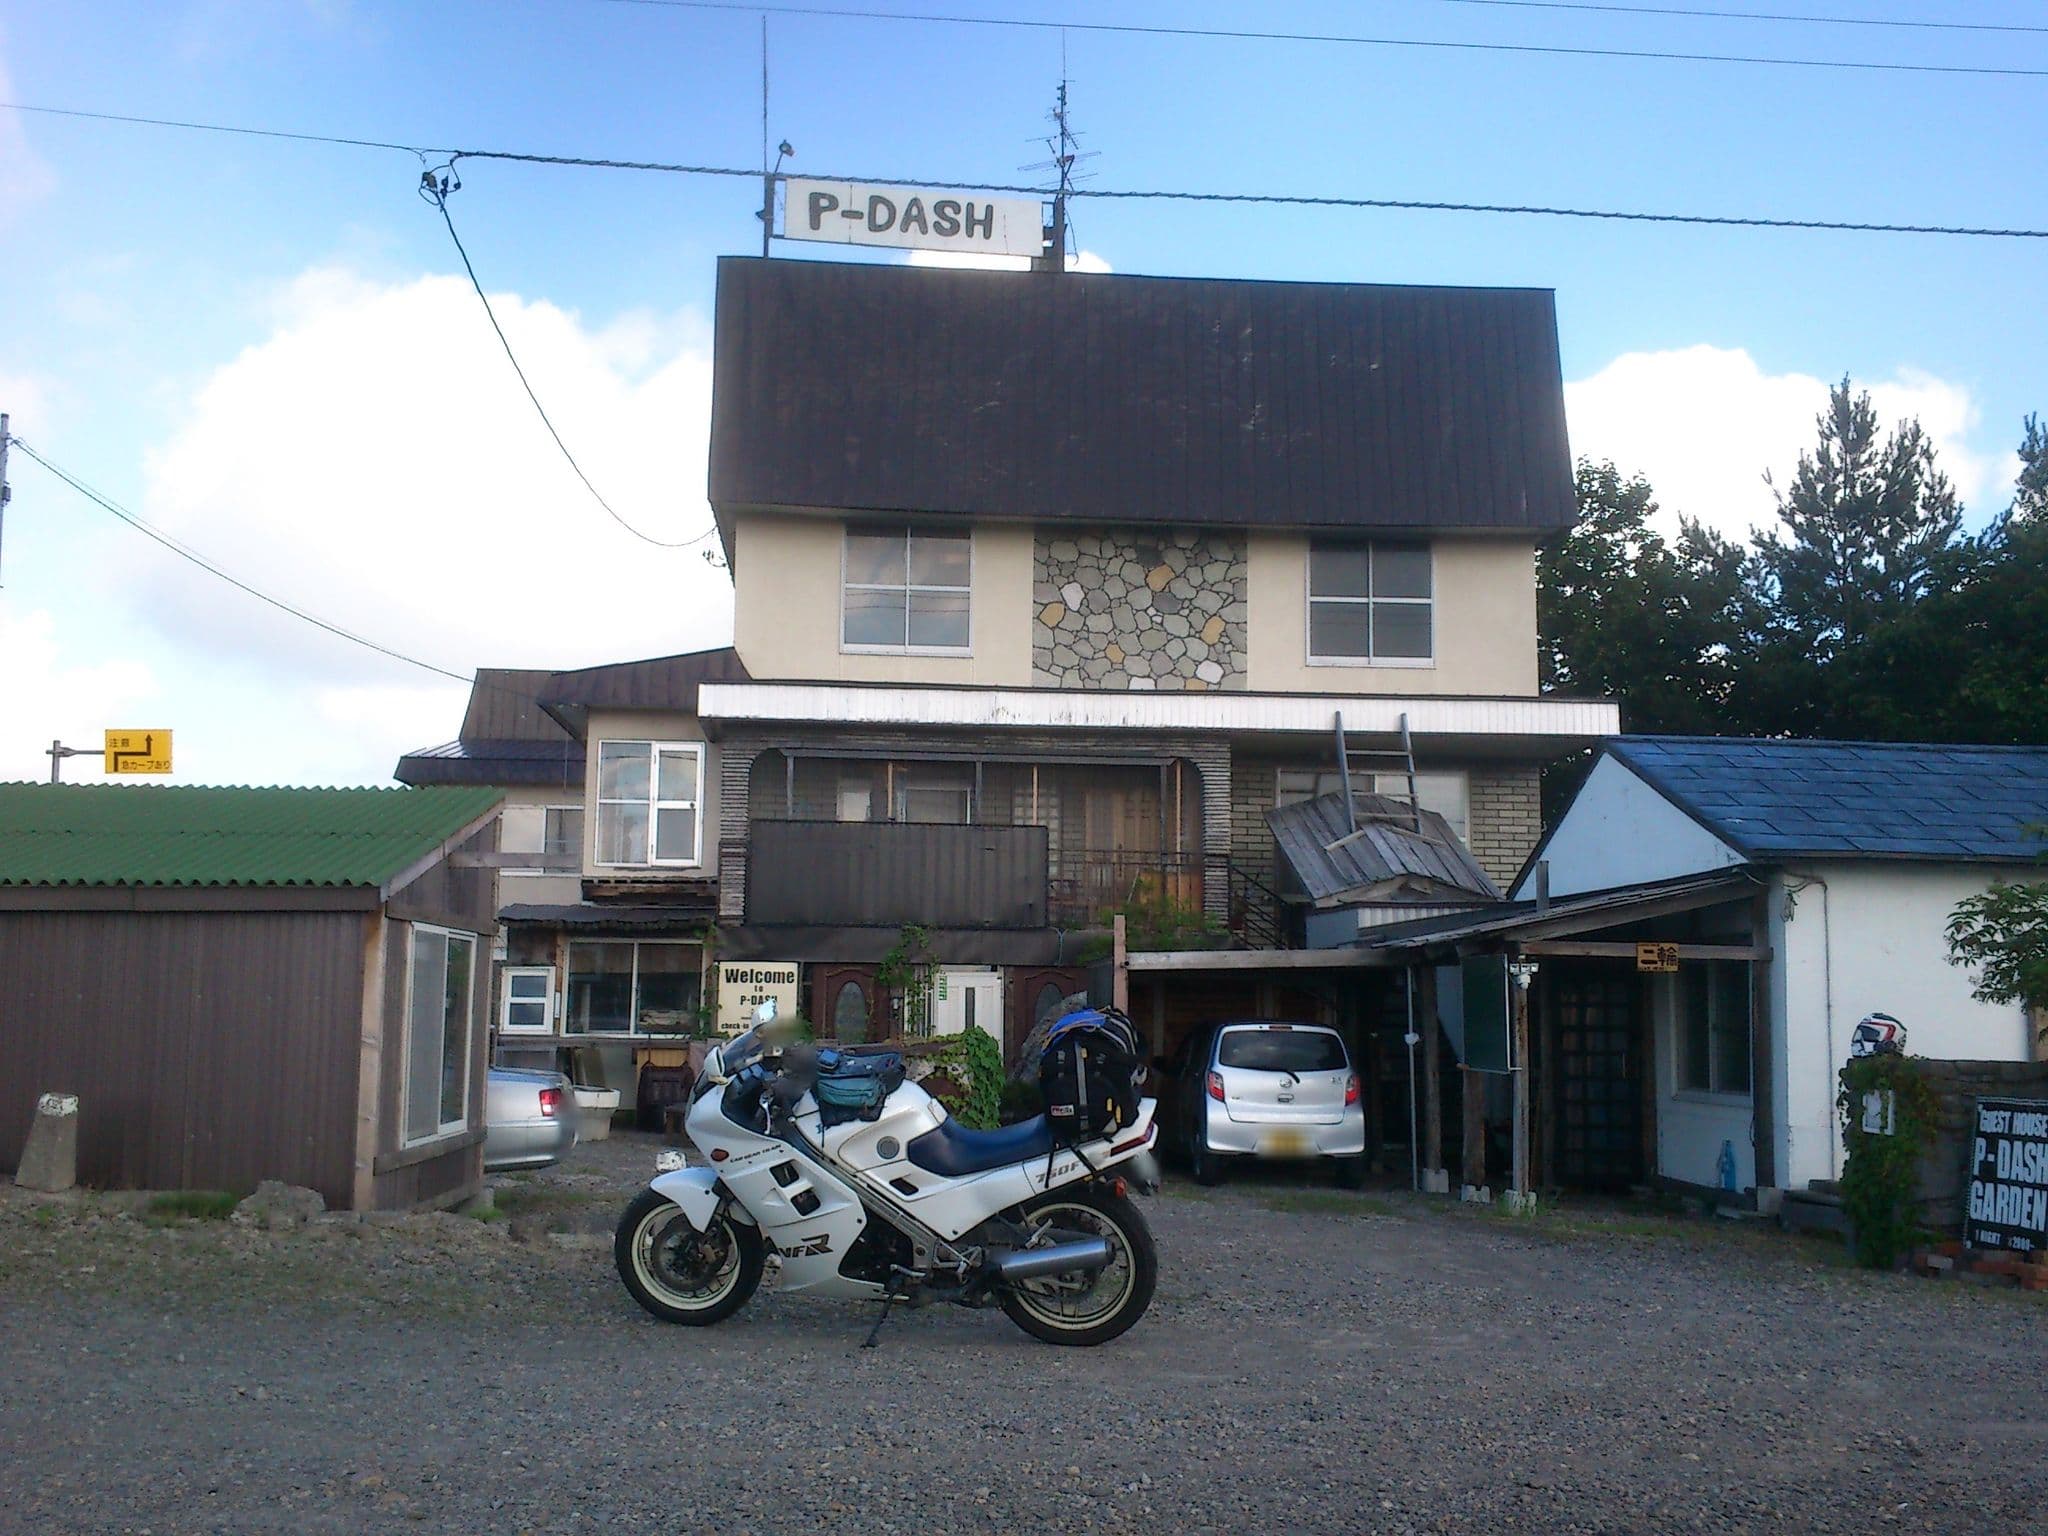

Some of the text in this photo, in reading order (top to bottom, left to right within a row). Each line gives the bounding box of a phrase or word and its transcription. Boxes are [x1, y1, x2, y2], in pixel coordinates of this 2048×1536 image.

[808, 191, 994, 240] P-DASH
[725, 969, 795, 984] Welcome
[1980, 1109, 2012, 1134] GUEST
[1973, 1137, 2048, 1184] P-DASH
[1970, 1180, 2048, 1232] GARDEN
[779, 1233, 834, 1258] VFR
